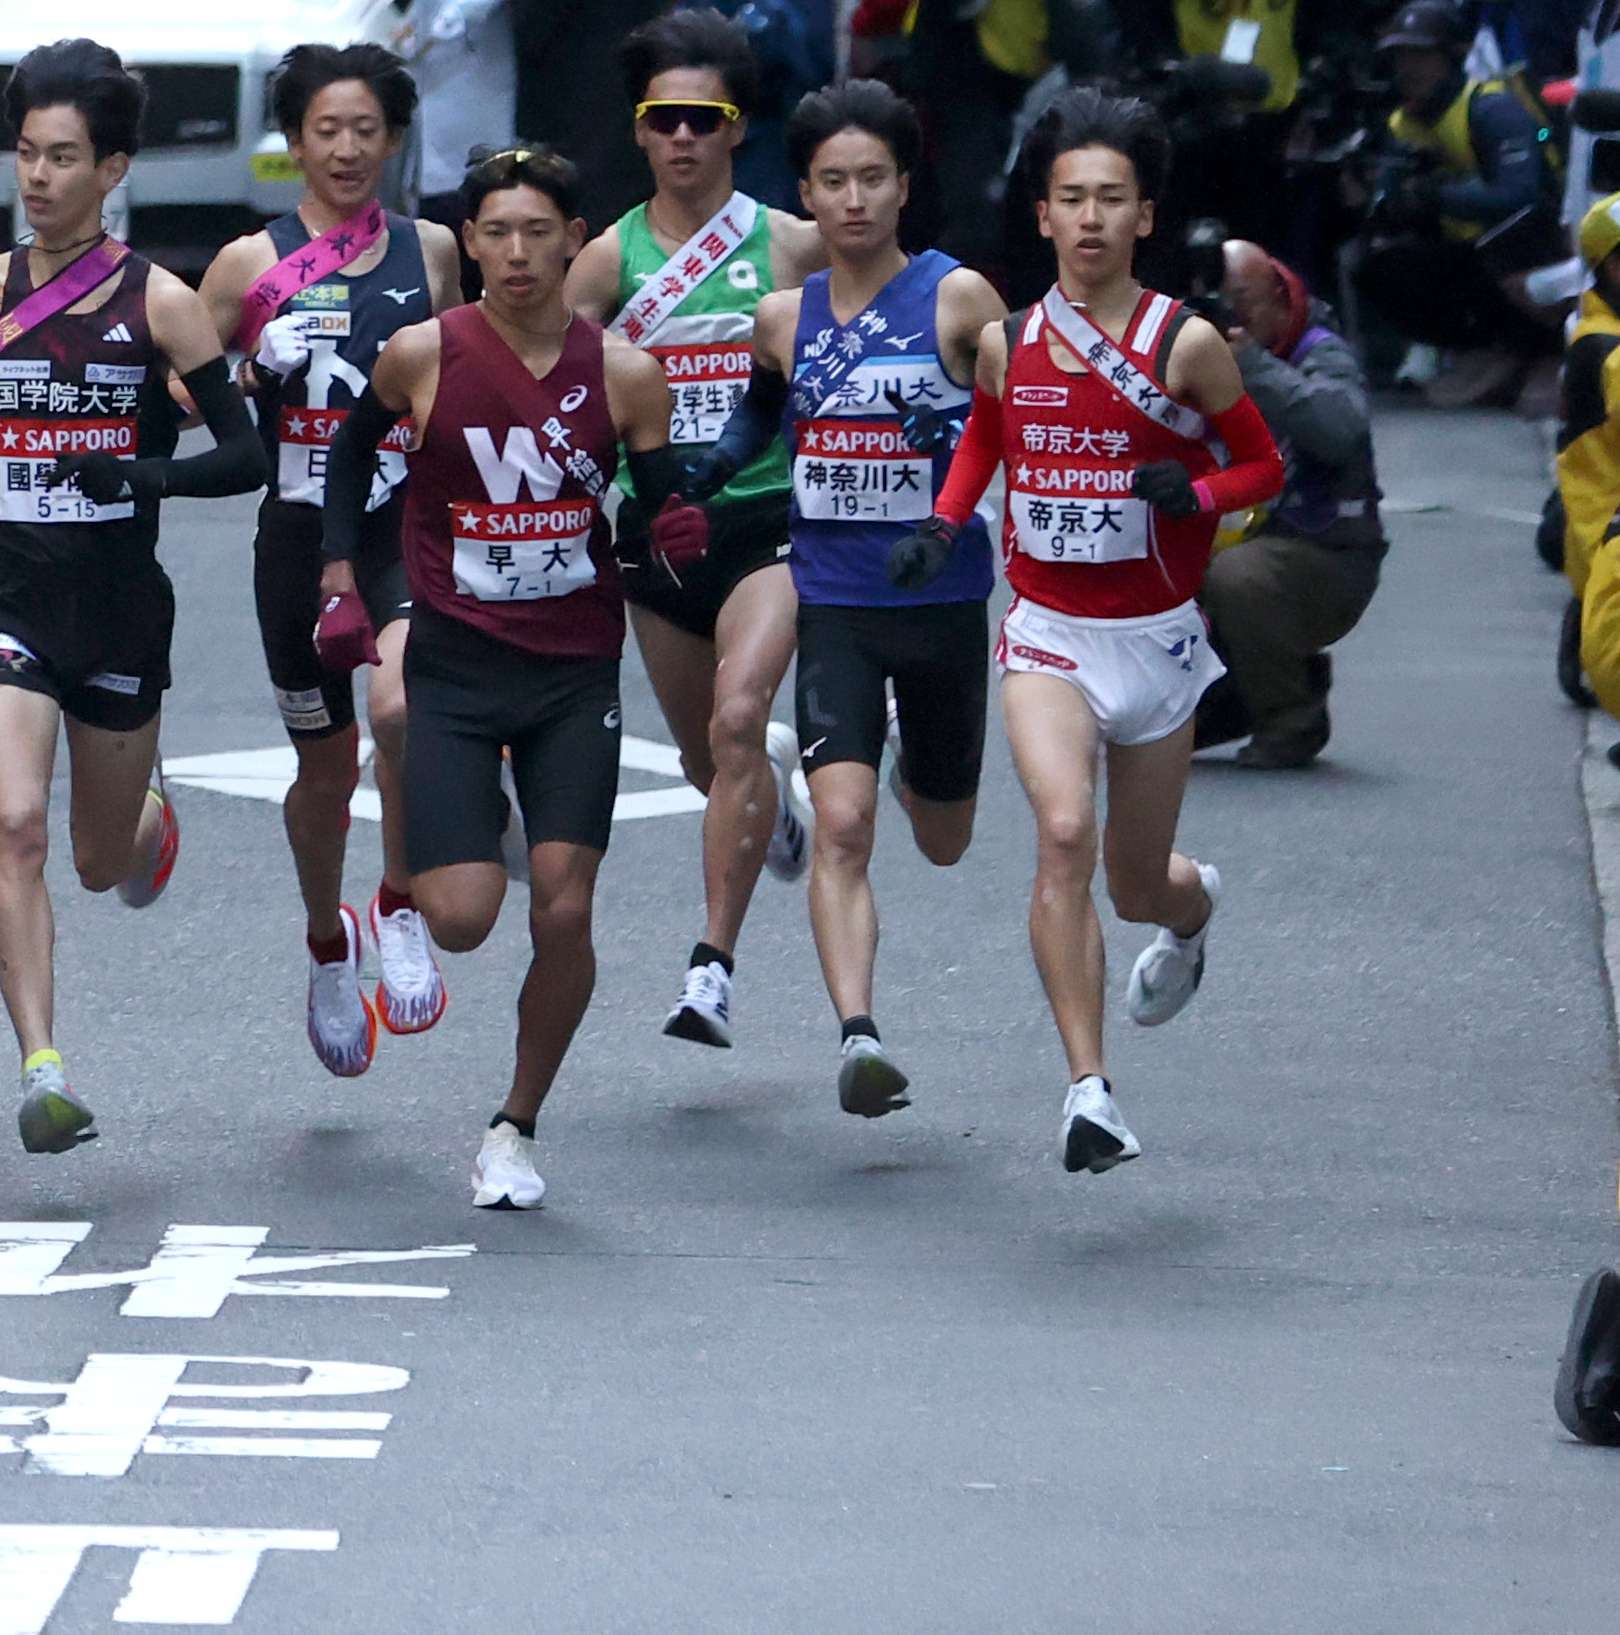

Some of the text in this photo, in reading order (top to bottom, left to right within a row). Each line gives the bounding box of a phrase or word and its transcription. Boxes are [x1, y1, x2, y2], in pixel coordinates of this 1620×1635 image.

[25, 427, 131, 452] SAPPORO
[1022, 422, 1131, 459] 帝京大学
[462, 426, 566, 504] W
[804, 461, 921, 493] 神奈川大
[37, 496, 96, 518] 5-15
[831, 496, 889, 517] 19-1
[1028, 499, 1123, 534] 帝京大
[487, 507, 592, 535] SAPPORO
[1052, 535, 1096, 560] 9-1
[506, 577, 551, 597] 7-1
